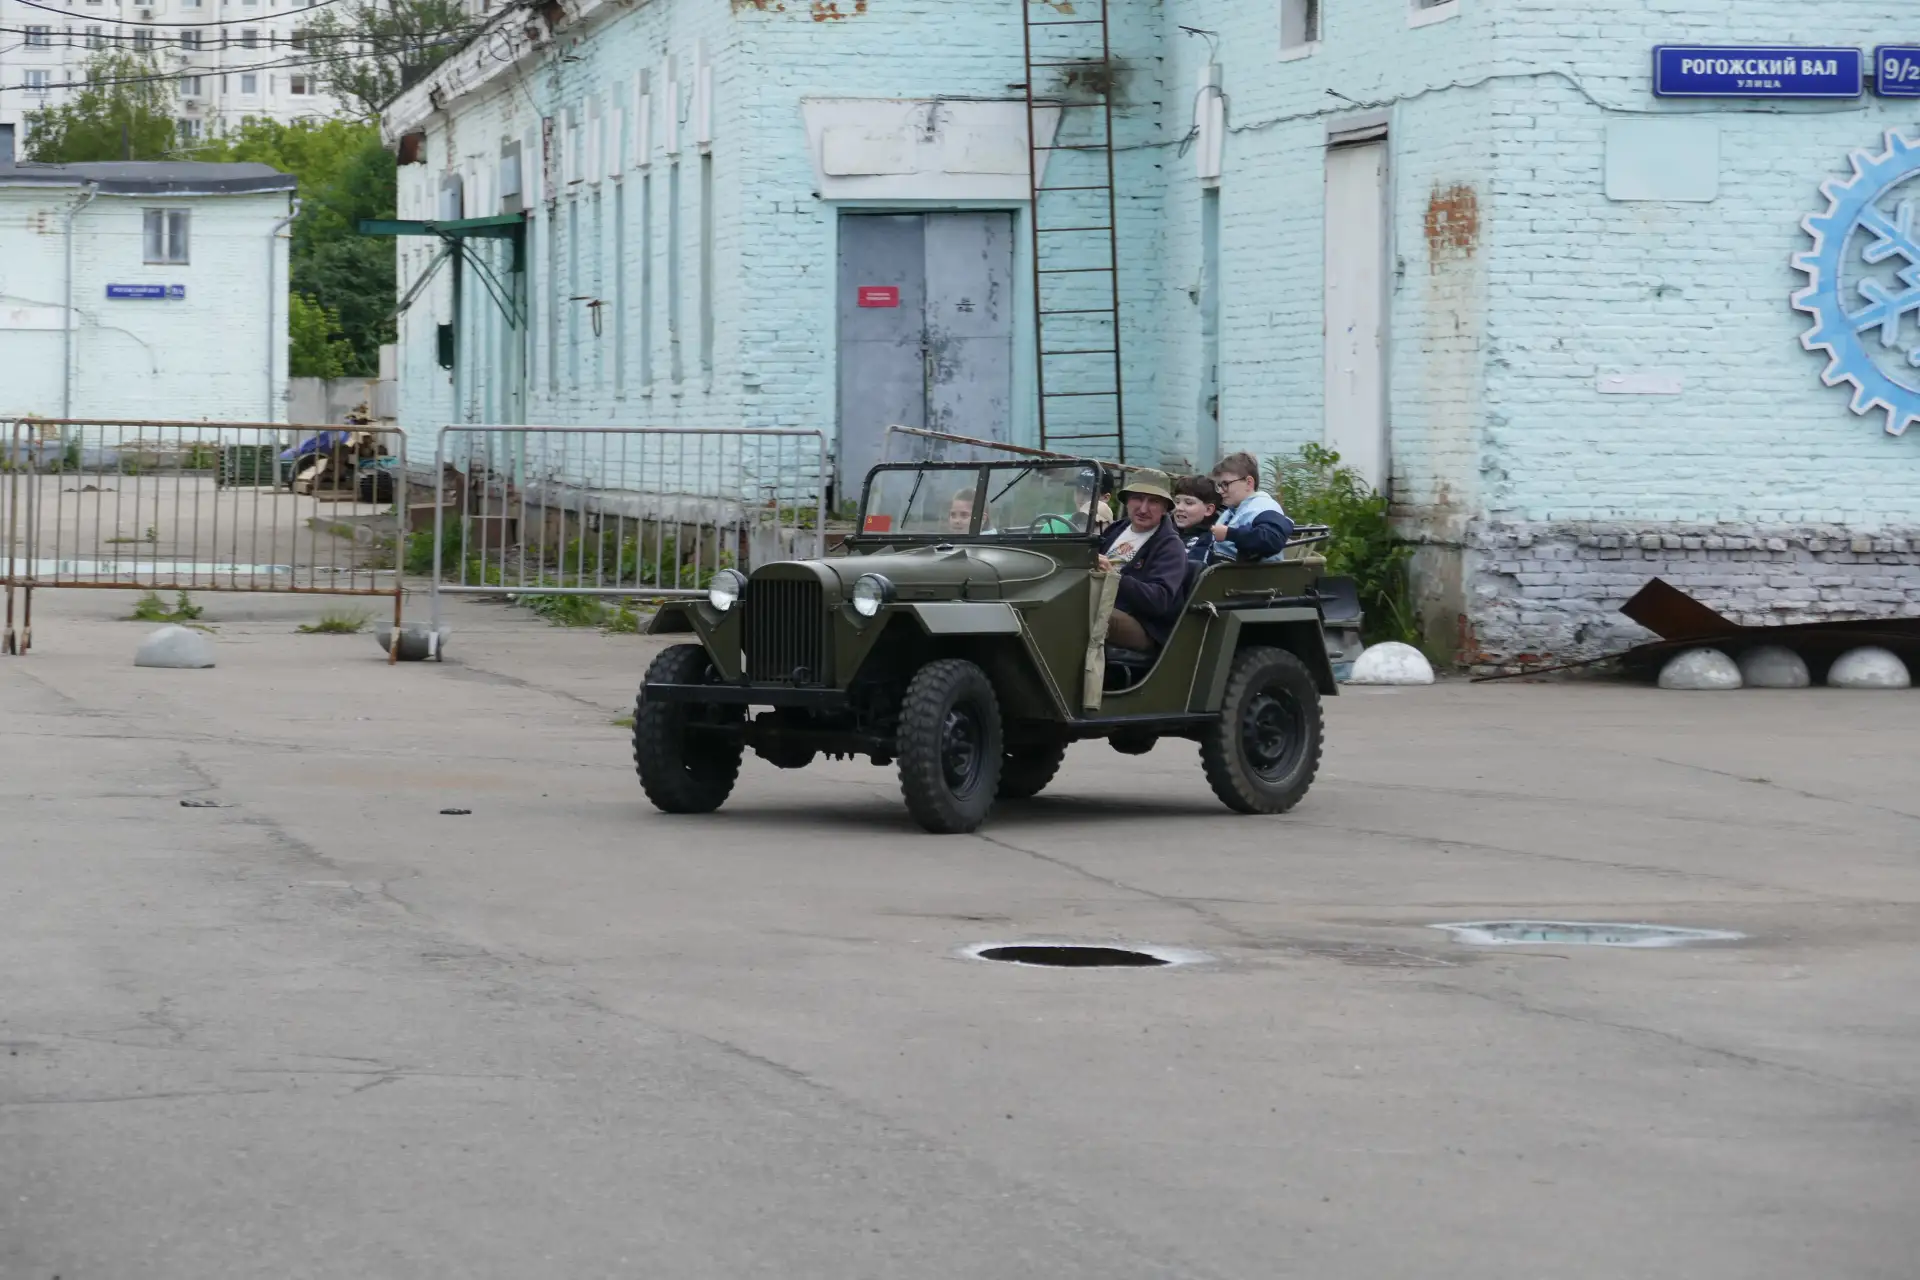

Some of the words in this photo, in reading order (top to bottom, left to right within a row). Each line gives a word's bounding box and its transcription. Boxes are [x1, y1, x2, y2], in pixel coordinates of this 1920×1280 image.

[1681, 57, 1797, 75] РОГОЖСКИЙ
[1801, 60, 1838, 76] ВАЛ
[1736, 79, 1782, 88] УЛИЦА
